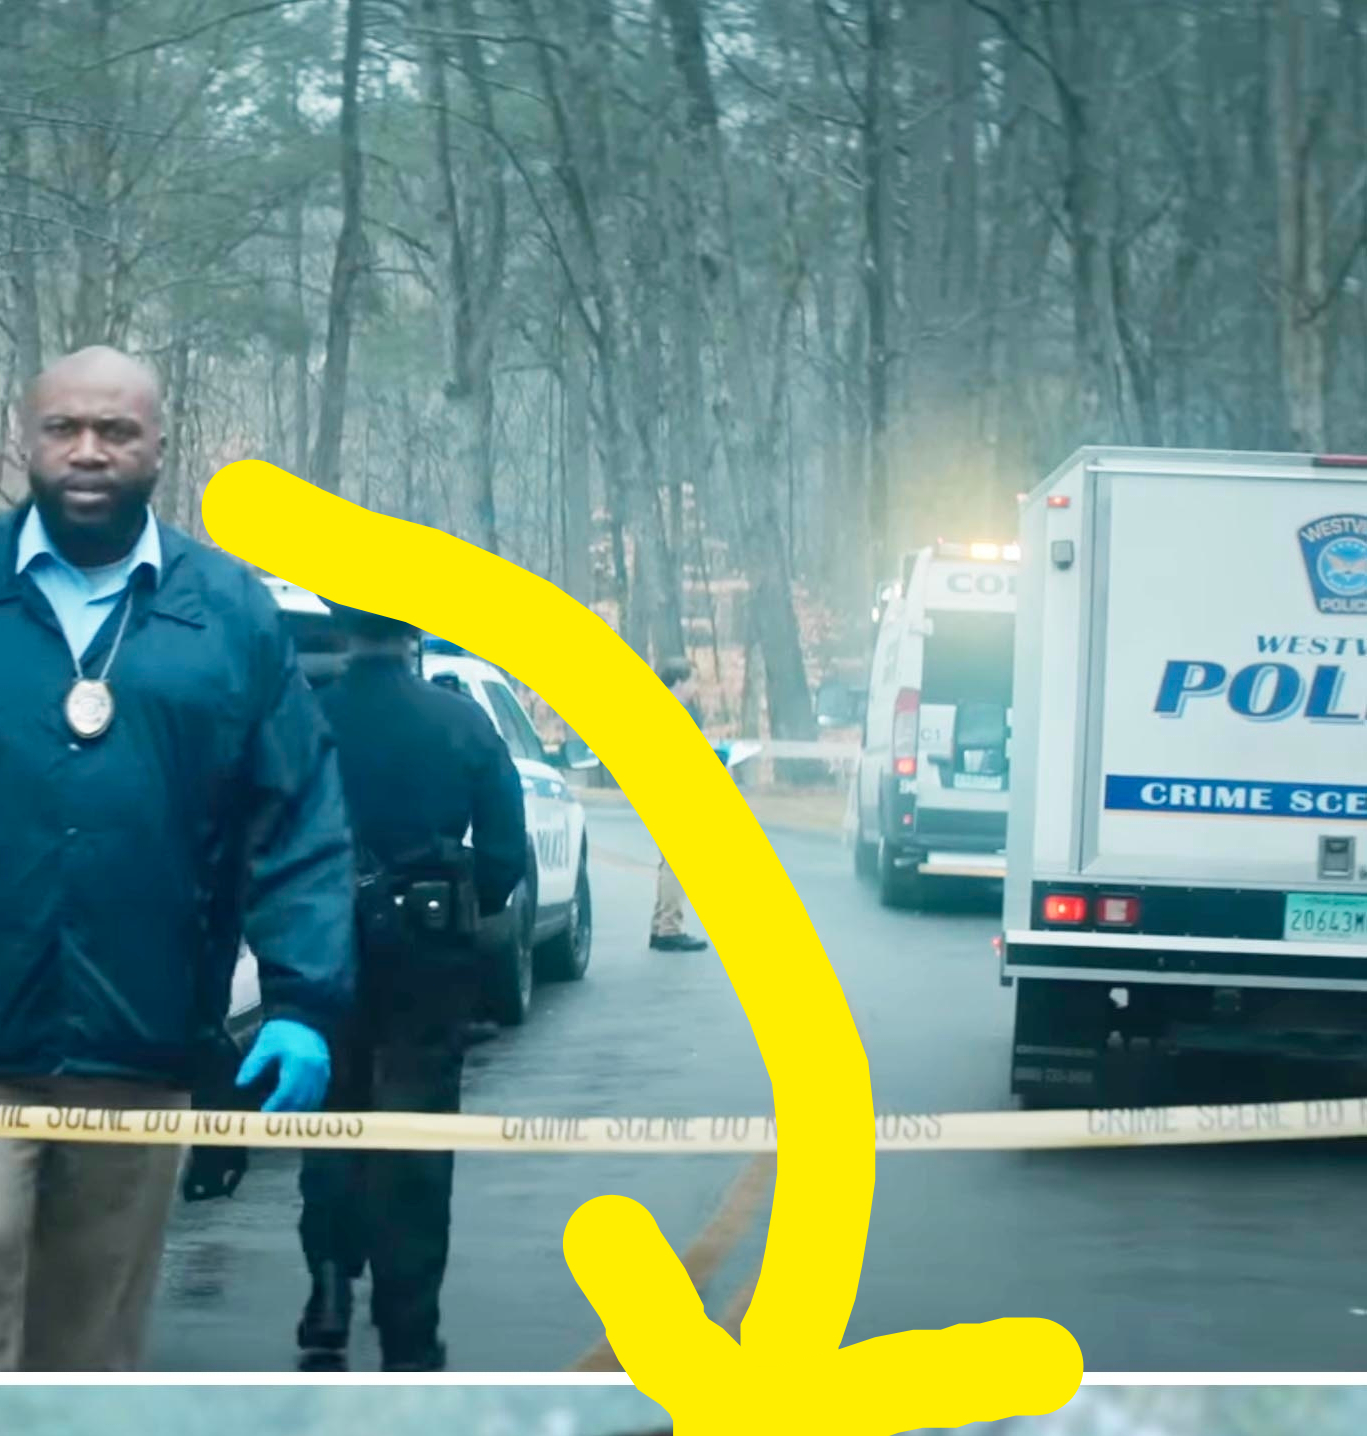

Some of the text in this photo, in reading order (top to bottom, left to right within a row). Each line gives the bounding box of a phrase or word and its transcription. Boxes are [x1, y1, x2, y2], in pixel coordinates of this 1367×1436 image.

[1152, 659, 1367, 724] POL
[1140, 783, 1274, 811] CRIME
[1291, 908, 1367, 933] 20643M
[46, 1107, 130, 1132] SCENE
[1087, 1107, 1179, 1136] CRIME
[1196, 1103, 1289, 1131] SCENE
